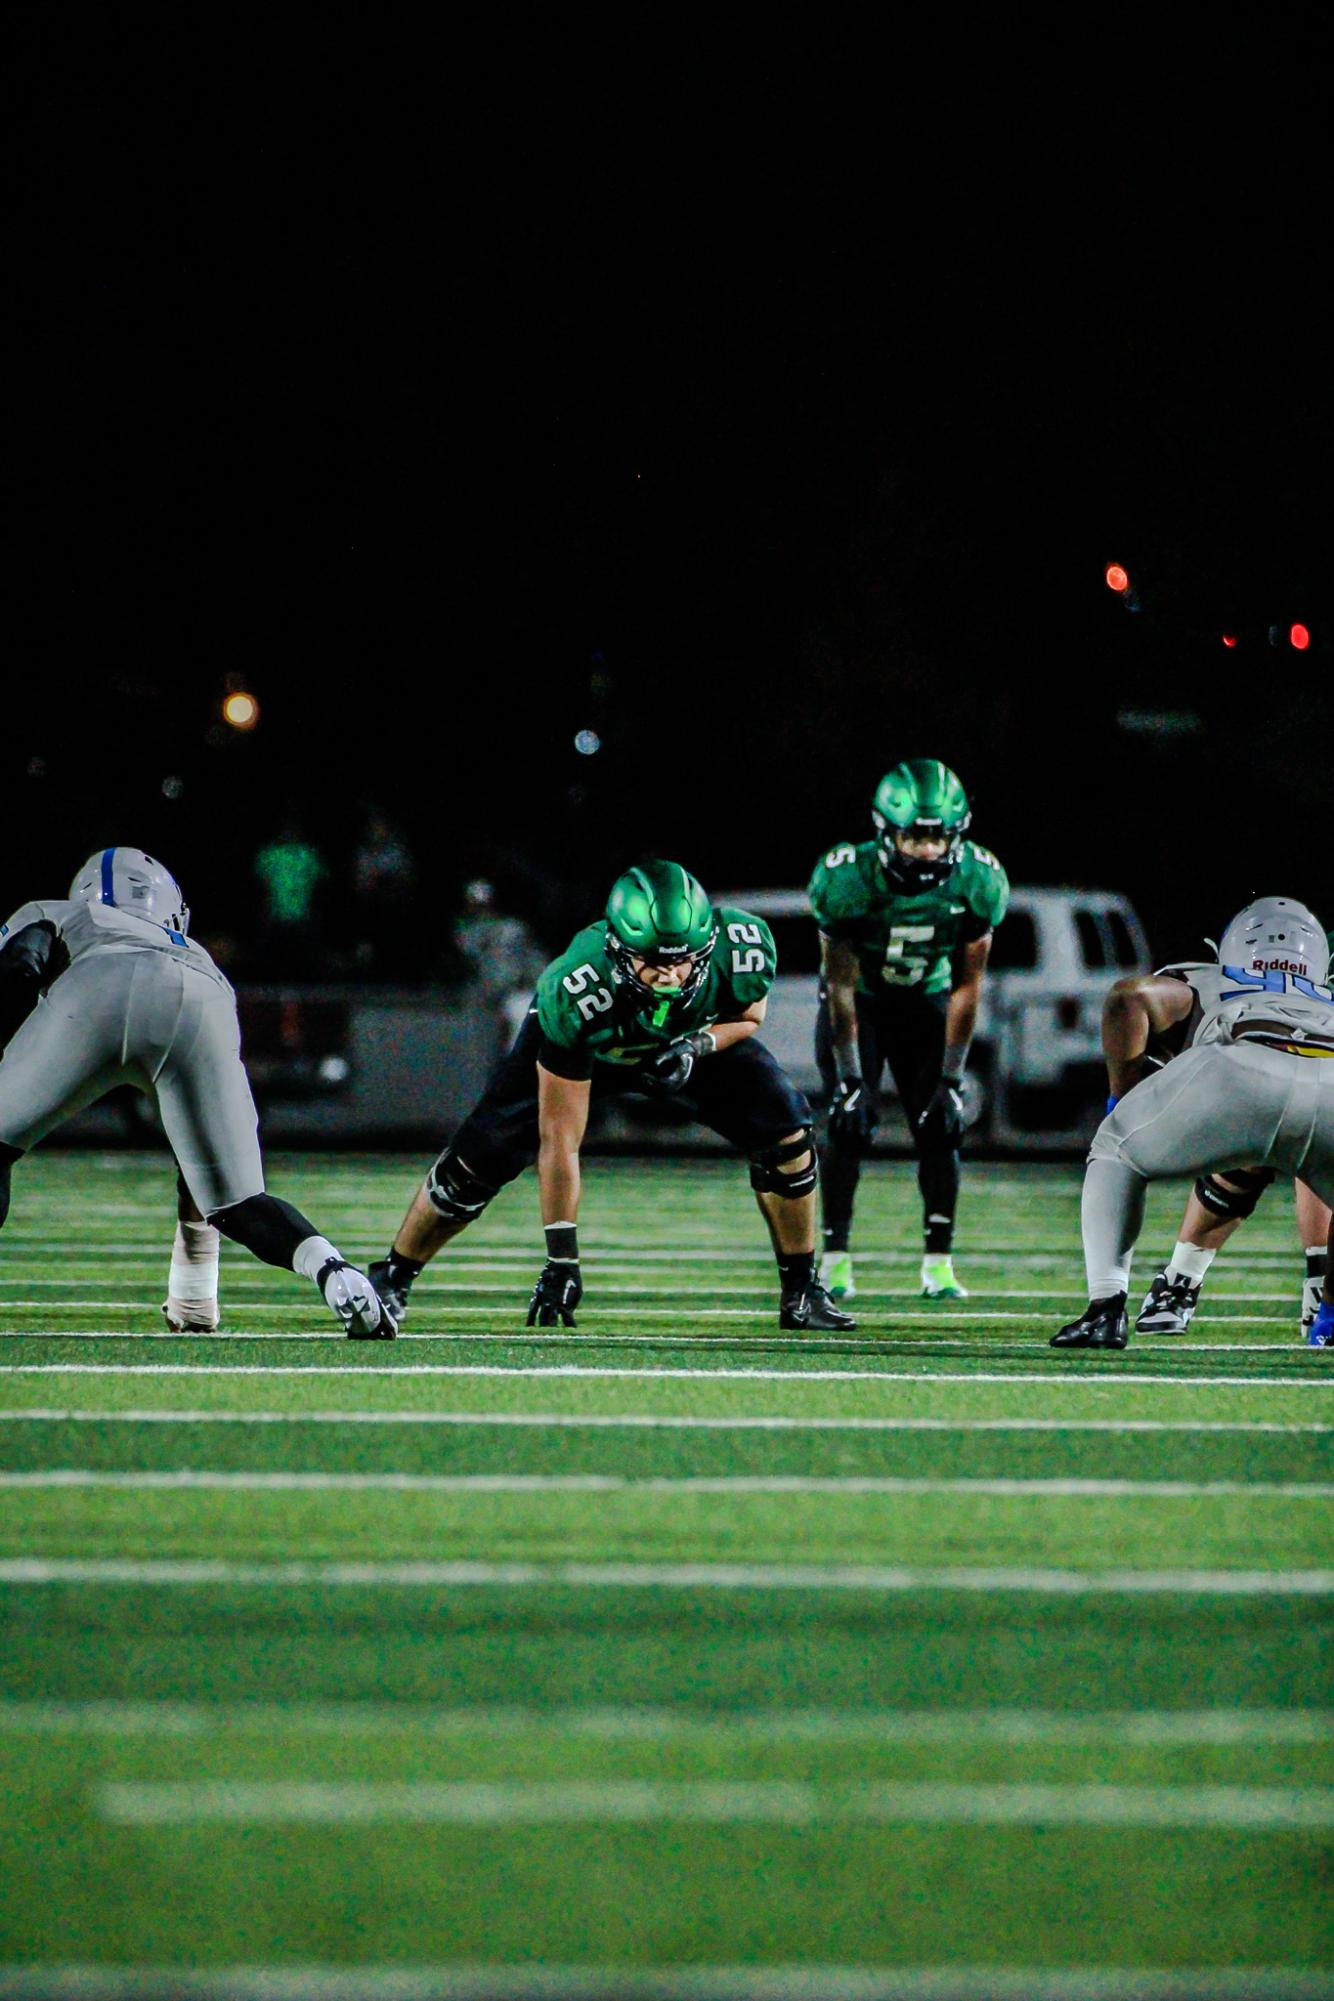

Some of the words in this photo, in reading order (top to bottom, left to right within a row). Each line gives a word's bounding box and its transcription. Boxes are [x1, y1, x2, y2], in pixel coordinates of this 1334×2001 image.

[825, 847, 856, 868] 5
[727, 922, 765, 973] 52
[881, 925, 935, 986] 5
[1252, 959, 1308, 976] Riddell
[562, 963, 614, 1021] 52
